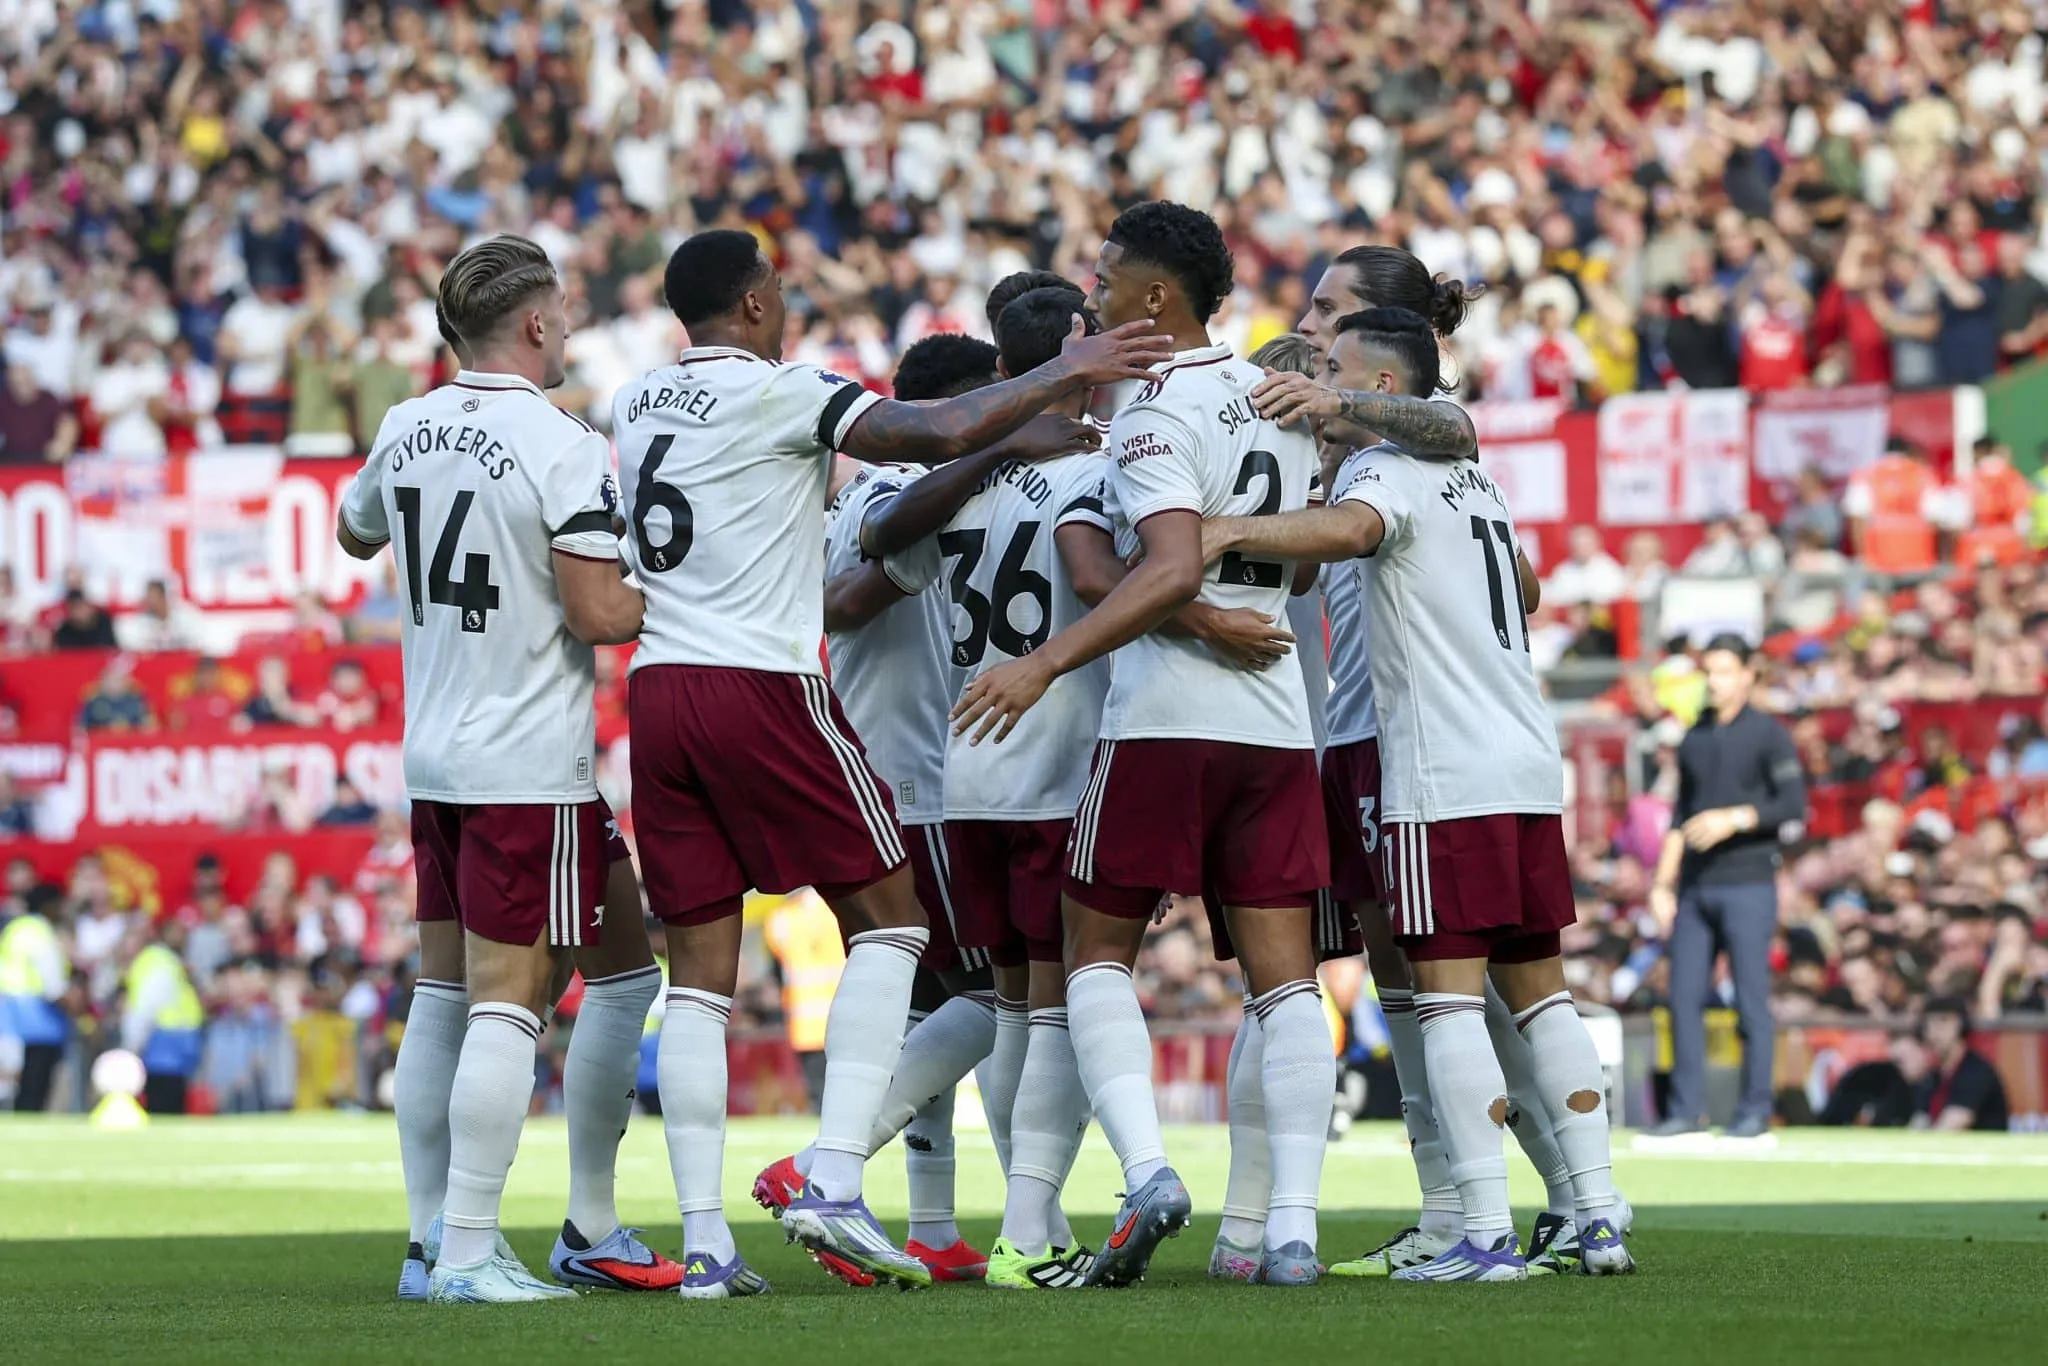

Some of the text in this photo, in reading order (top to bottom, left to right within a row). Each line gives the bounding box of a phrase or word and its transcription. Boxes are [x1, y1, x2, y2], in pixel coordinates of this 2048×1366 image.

[392, 419, 515, 480] GYÖKERES
[628, 387, 719, 423] GABRIEL
[1122, 433, 1154, 450] VISIT
[1218, 395, 1281, 436] SALI
[633, 434, 694, 573] 6
[1117, 443, 1173, 470] RWANDA
[393, 486, 500, 633] 14
[1218, 450, 1283, 589] 2
[937, 521, 1052, 668] 36
[1470, 515, 1529, 652] 11
